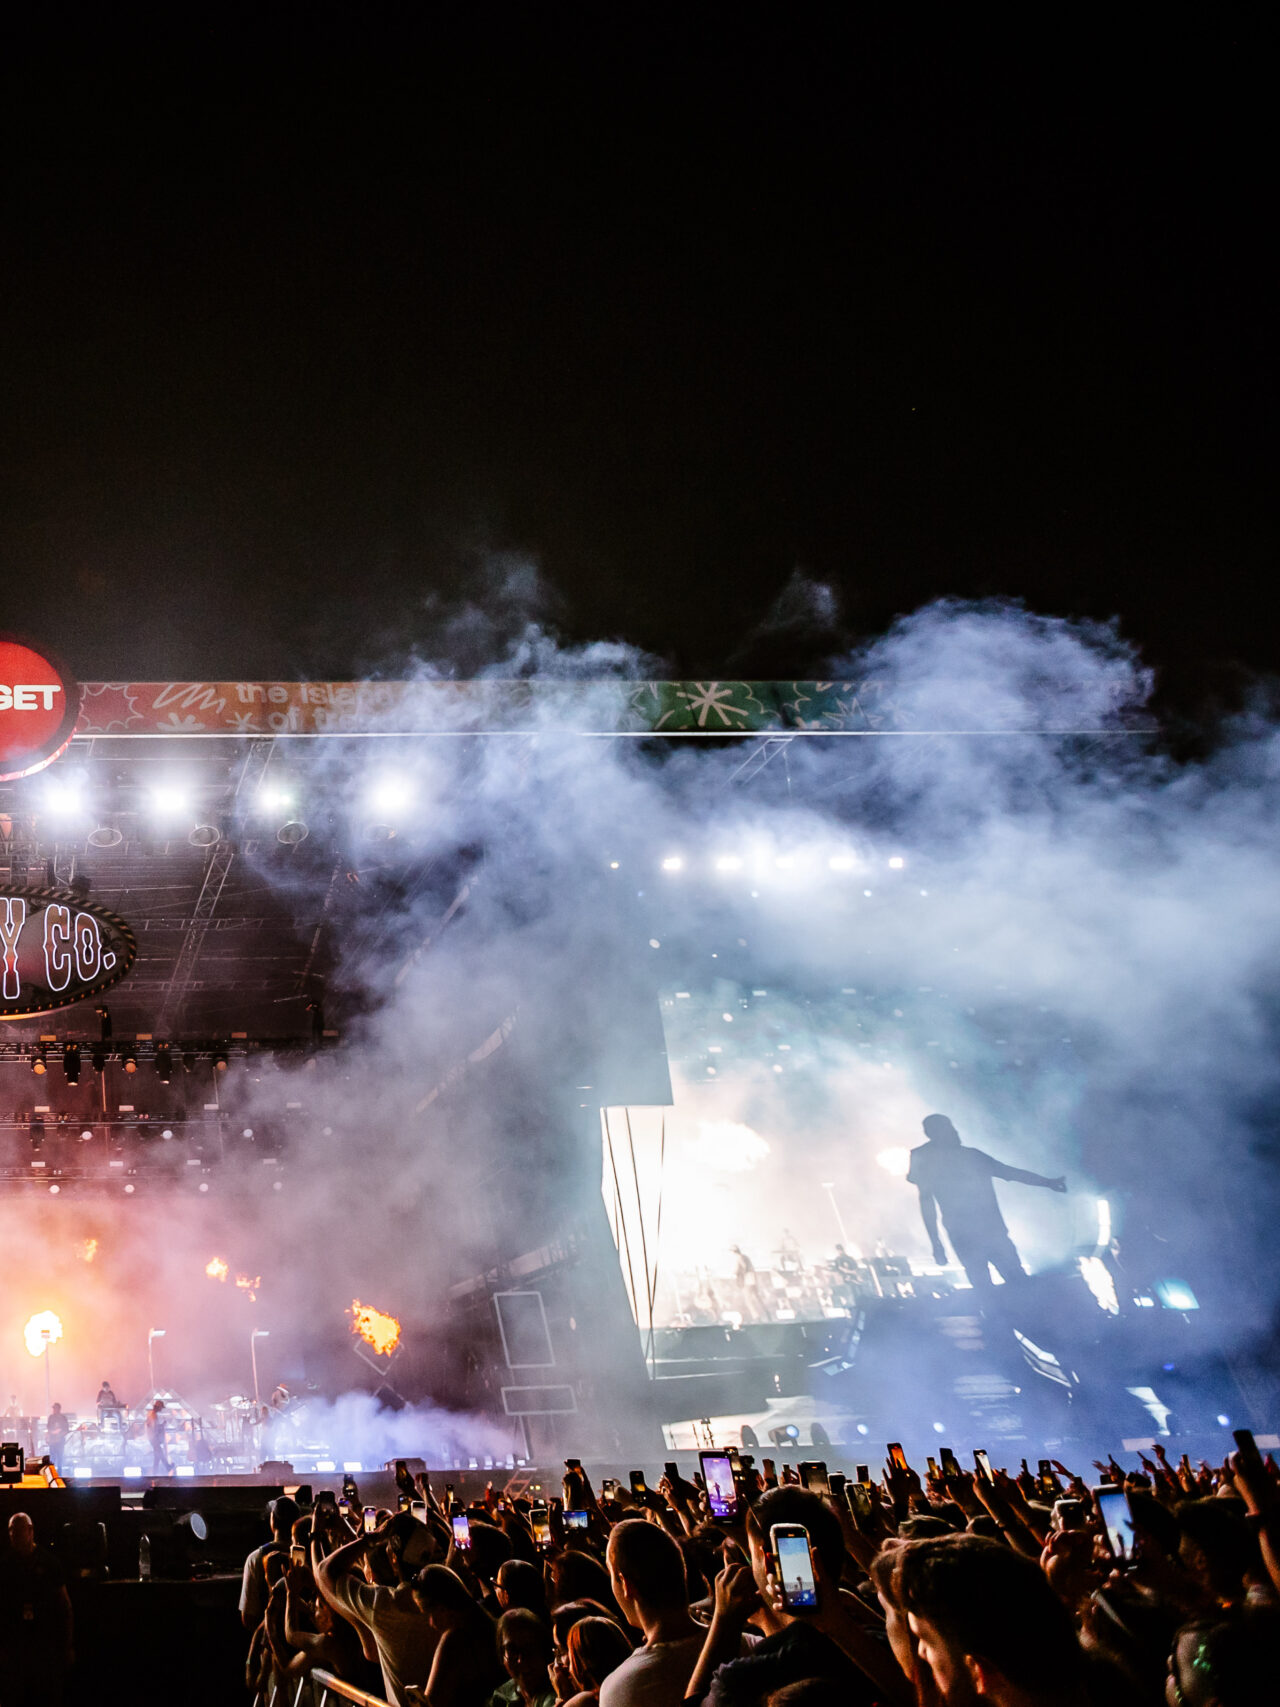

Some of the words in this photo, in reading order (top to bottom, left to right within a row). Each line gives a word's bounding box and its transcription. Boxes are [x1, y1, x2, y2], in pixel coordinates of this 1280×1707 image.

[235, 683, 288, 704] the
[267, 705, 300, 731] of
[43, 904, 116, 992] CO.
